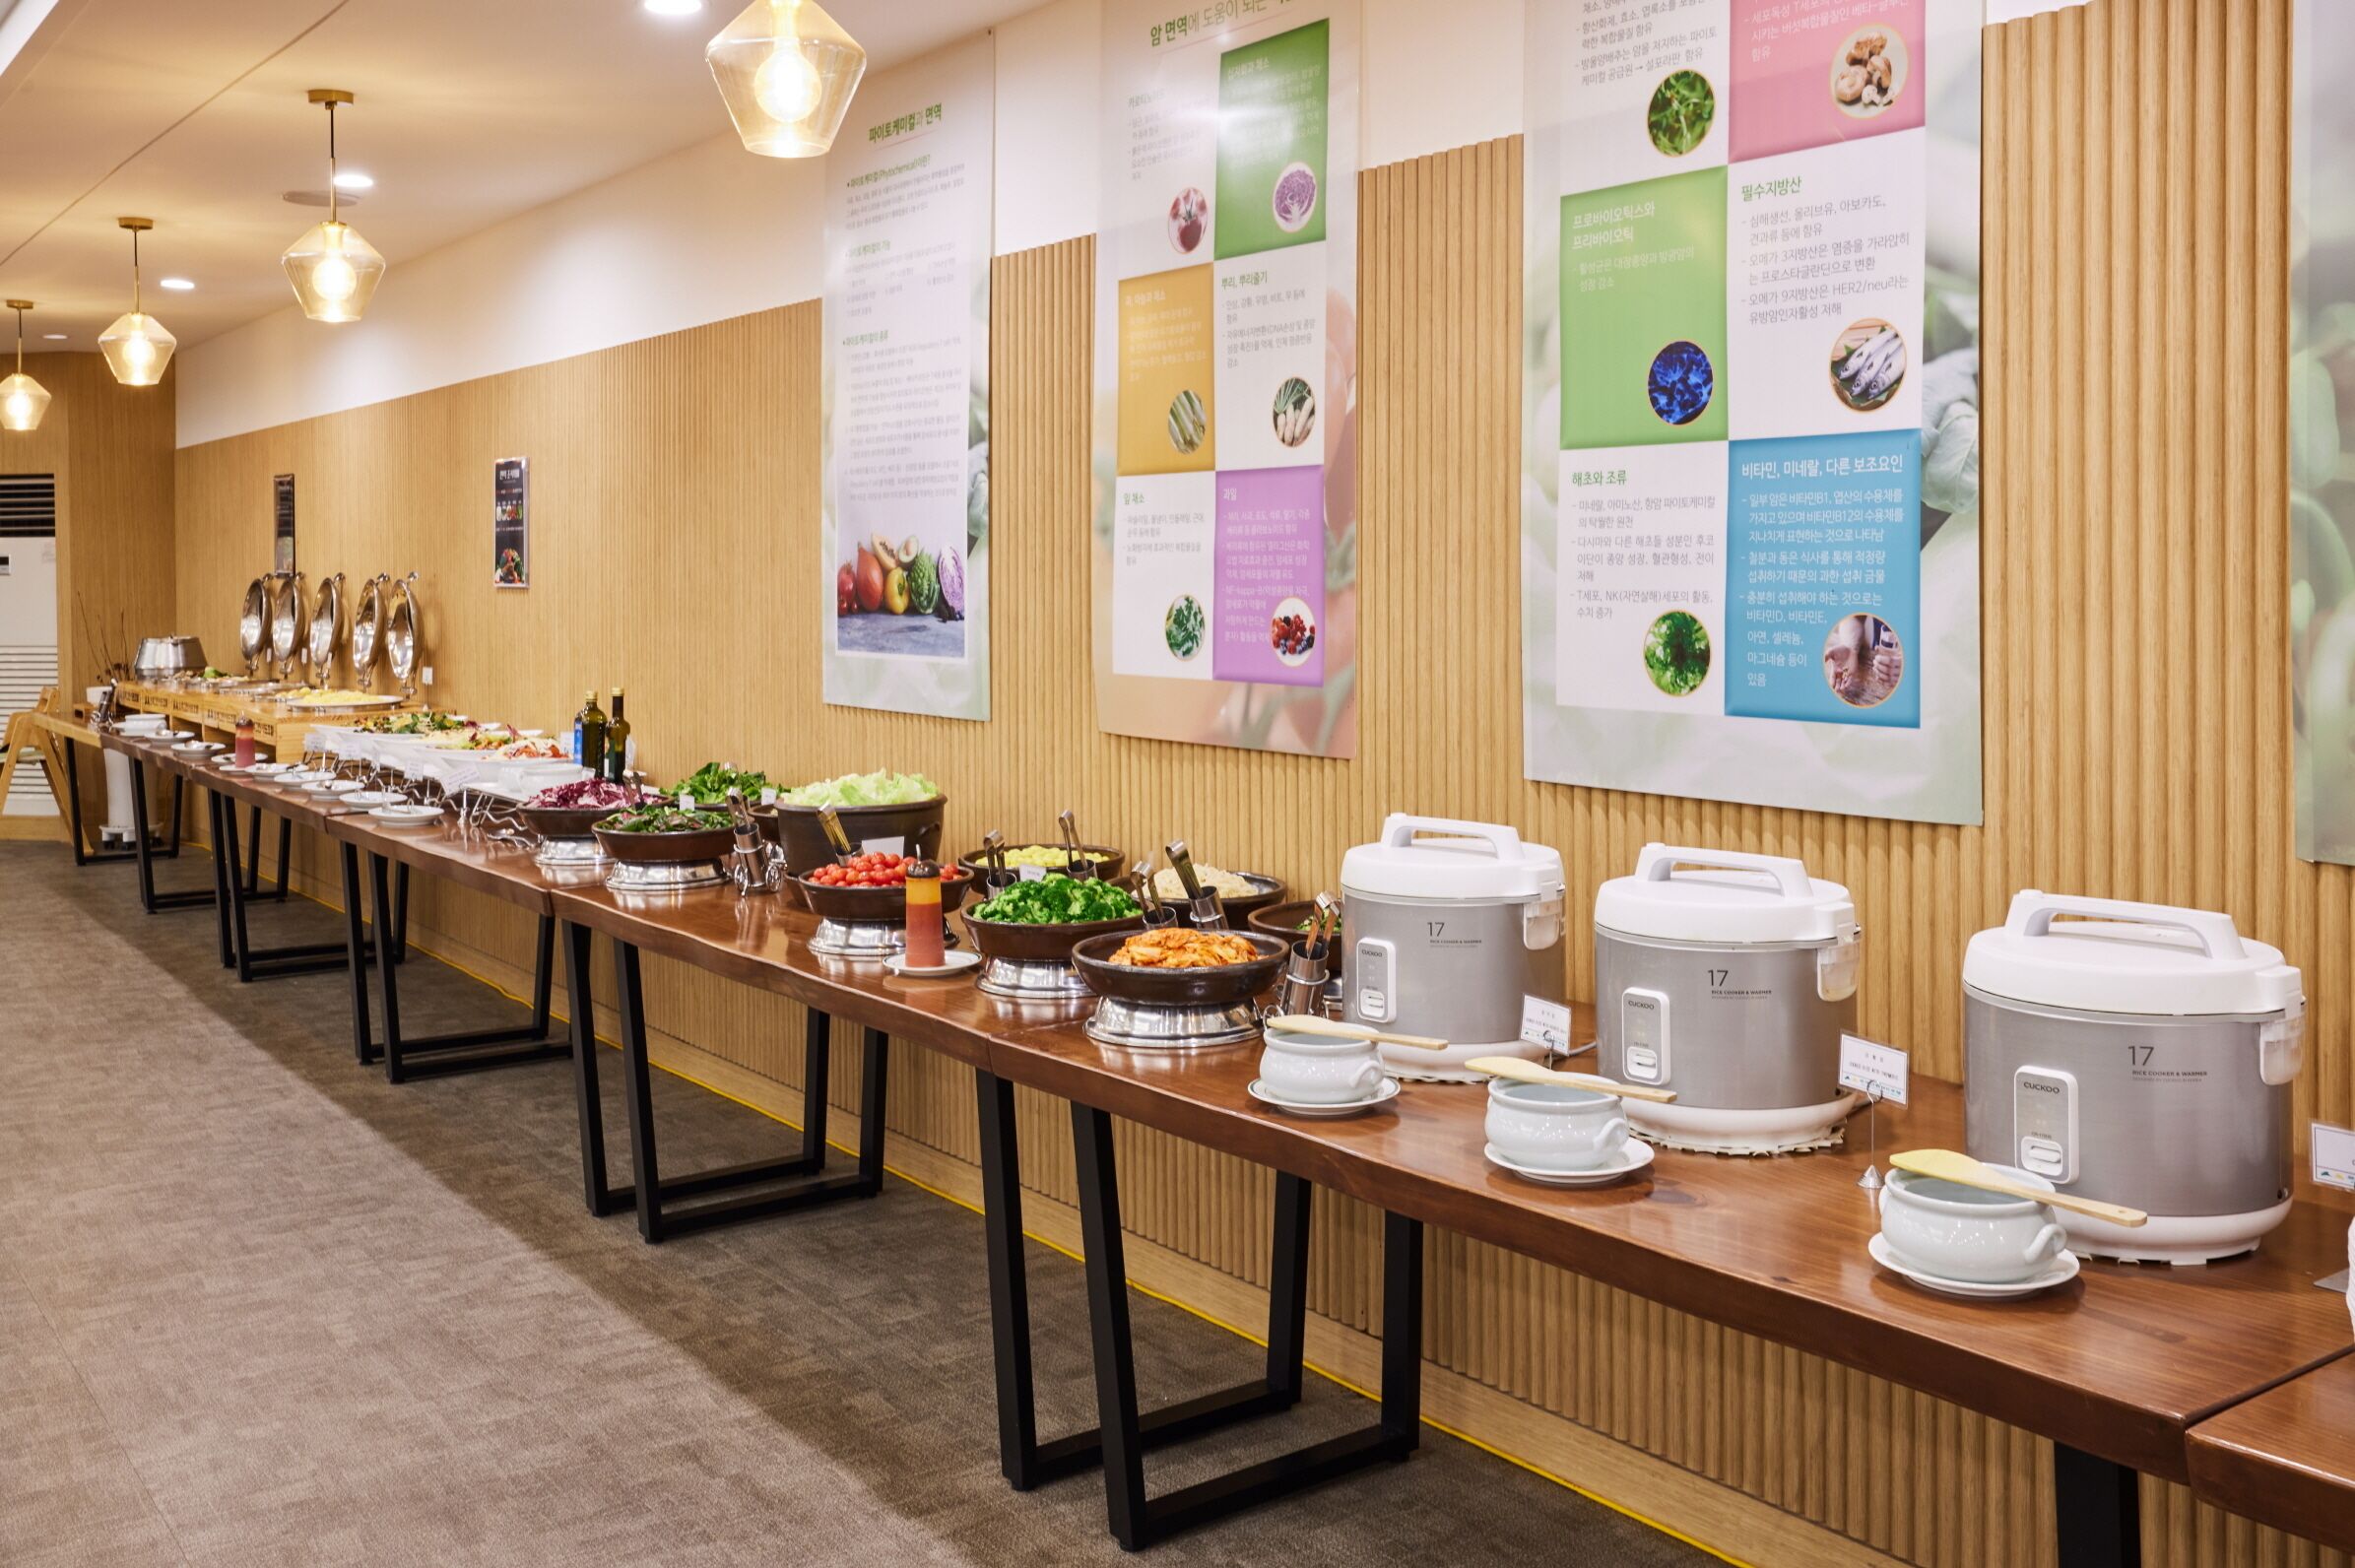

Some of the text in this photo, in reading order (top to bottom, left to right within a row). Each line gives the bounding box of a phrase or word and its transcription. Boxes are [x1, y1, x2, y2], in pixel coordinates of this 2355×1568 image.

[1150, 25, 1162, 46] 암
[1165, 11, 1199, 41] 면역에
[1203, 0, 1238, 28] 도움이
[1621, 10, 1639, 23] 효소,
[1751, 4, 1791, 25] 세포독성
[1635, 22, 1653, 37] 함유
[1751, 27, 1779, 41] 시키는
[1781, 9, 1851, 33] 버섯복합물질인
[1581, 48, 1630, 71] 방울양배추는
[1652, 34, 1686, 51] 저지하는
[1690, 26, 1717, 41] 파이토
[1751, 45, 1772, 63] 함유
[1581, 70, 1605, 87] 케미컬
[1607, 63, 1633, 79] 공급원
[1685, 47, 1703, 62] 함유
[869, 102, 943, 143] 파이토케미컬과 면역
[1741, 175, 1802, 202] 필수지방산
[1572, 200, 1655, 229] 프로바이오틱스와
[1750, 195, 1886, 229] 심해생선, 올리브유, 아보카도,
[1571, 227, 1633, 250] 프리바이오틱
[1749, 222, 1823, 246] 견과류 등에 함유
[1749, 231, 1910, 267] 오메가 3지방산은 염증을 가라앉히
[1749, 256, 1875, 286] 는 프로스타글란딘으로 변환
[1749, 275, 1910, 306] 오메가 9지방산은 HER2/neu라는
[1749, 301, 1842, 325] 유방암인자활성 저해
[1741, 454, 1903, 481] 비타민, 미네랄, 다른 보조요인
[1572, 469, 1627, 487] 해초와 조류
[1579, 495, 1716, 512] 미네랄, 아미노산, 항암 파이토케미컬
[1749, 488, 1903, 508] 일부 암은 비타민B1, 엽산의 수용체를
[1578, 517, 1587, 528] 의
[1616, 515, 1634, 529] 원천
[1749, 507, 1904, 525] 가지고 있으며 비타민B12의 수용체를
[1578, 534, 1715, 549] 다시마와 다른 해초들 성분인 후코
[1749, 528, 1884, 545] 지나치게 표현하는 것으로 나타남
[1577, 552, 1715, 566] 이단이 종양 성장, 혈관형성, 전이
[1749, 552, 1777, 565] 철분과
[1800, 551, 1829, 565] 식사를
[1832, 551, 1853, 565] 통해
[1855, 551, 1885, 565] 적정량
[1577, 570, 1595, 582] 저해
[1748, 570, 1786, 584] 섭취하기
[1820, 570, 1839, 584] 과한
[1842, 569, 1862, 584] 섭취
[1865, 569, 1885, 584] 금물
[1577, 590, 1603, 603] T세포,
[1605, 590, 1689, 604] NK(자연살해)세포의
[1747, 591, 1883, 607] 충분히 섭취해야 하는 것으로는
[1577, 606, 1613, 620] 수치 증가
[1746, 610, 1828, 624] 비타민D, 비타민E,
[1747, 631, 1804, 646] 아연, 셀레늄,
[1747, 652, 1807, 667] 마그네슘 등이
[1747, 673, 1766, 687] 있음
[1427, 922, 1445, 937] 17
[1361, 948, 1383, 957] CUCKOO
[1708, 969, 1729, 987] 17
[1628, 1000, 1655, 1011] CUCKOO
[2127, 1046, 2154, 1067] 17
[2024, 1081, 2061, 1094] CUCKOO
